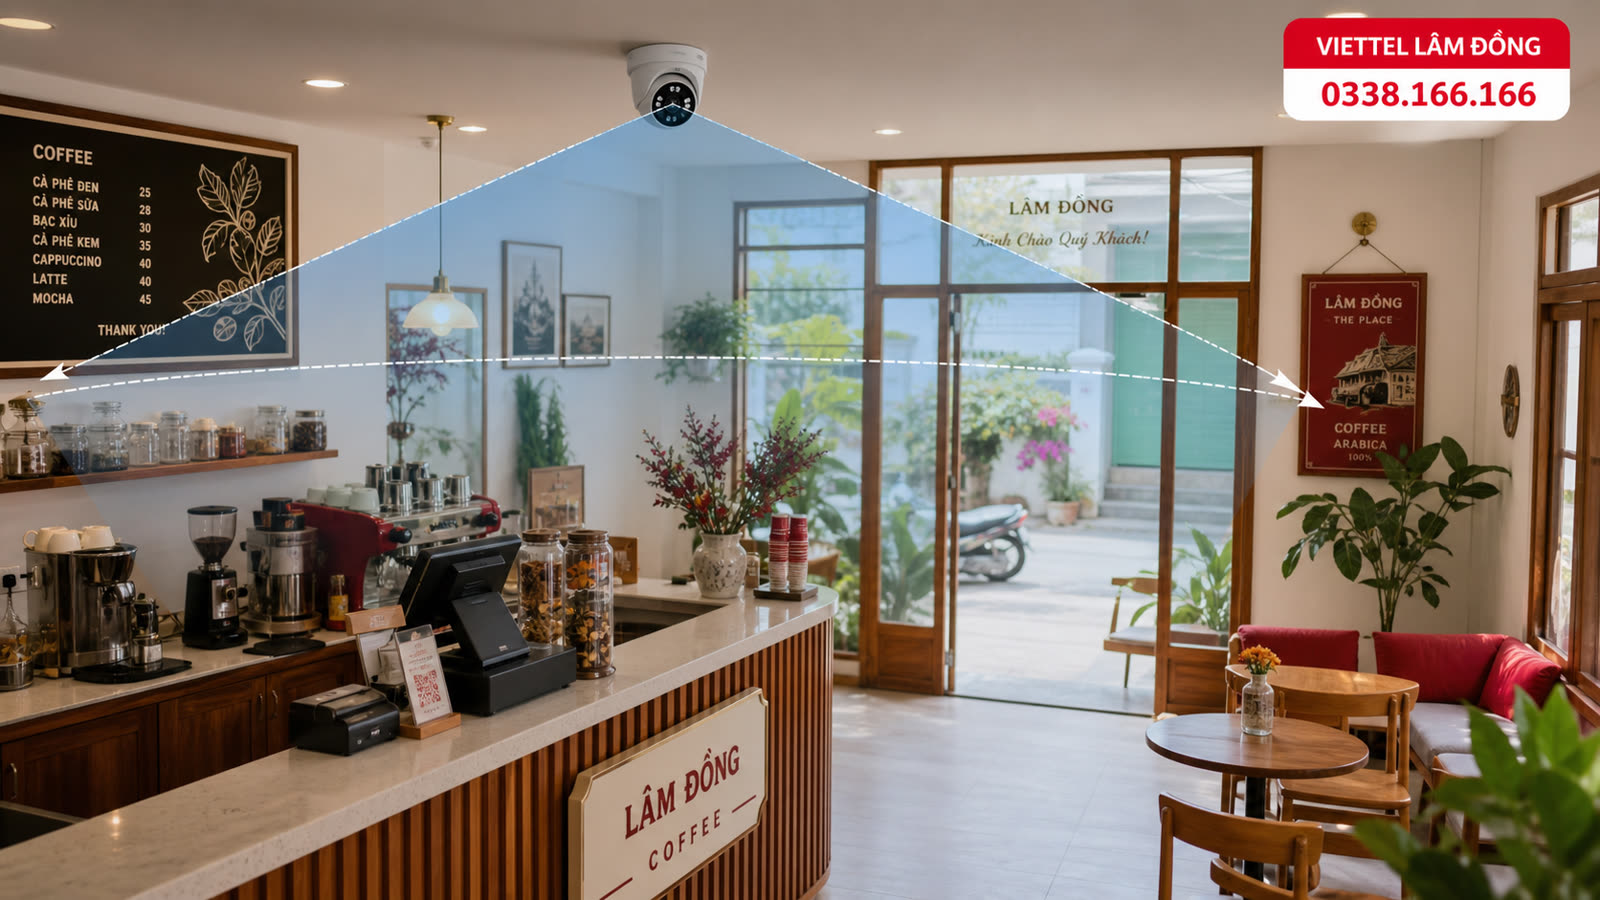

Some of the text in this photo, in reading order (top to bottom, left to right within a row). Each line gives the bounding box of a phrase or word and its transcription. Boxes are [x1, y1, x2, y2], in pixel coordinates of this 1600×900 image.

[33, 144, 93, 166] COFFEE
[33, 173, 48, 189] CÀ
[52, 176, 74, 191] PHÊ
[139, 186, 151, 198] 25
[52, 195, 74, 210] PHÊ
[139, 204, 151, 216] 28
[1009, 194, 1113, 216] LÂM ĐỒNG
[33, 214, 56, 230] BẠC
[139, 222, 151, 234] 30
[52, 233, 74, 247] PHÊ
[77, 236, 100, 249] KEM
[139, 240, 151, 252] 35
[1016, 231, 1053, 247] Chào
[1059, 230, 1089, 251] Quý
[1092, 229, 1150, 246] Khách!
[33, 253, 152, 270] CAPPUCCINO 40
[33, 272, 152, 288] LATTE 40
[33, 292, 152, 306] MOCHA 45
[1325, 294, 1356, 309] LÂM
[1334, 315, 1393, 324] THE PLACE
[98, 324, 166, 337] THANK YOU!
[1334, 422, 1387, 435] COFFEE
[1333, 439, 1387, 450] ARABICA
[1348, 453, 1372, 462] 100%
[625, 745, 740, 840] LÂM ĐỒNG
[648, 808, 721, 871] COFFEE
